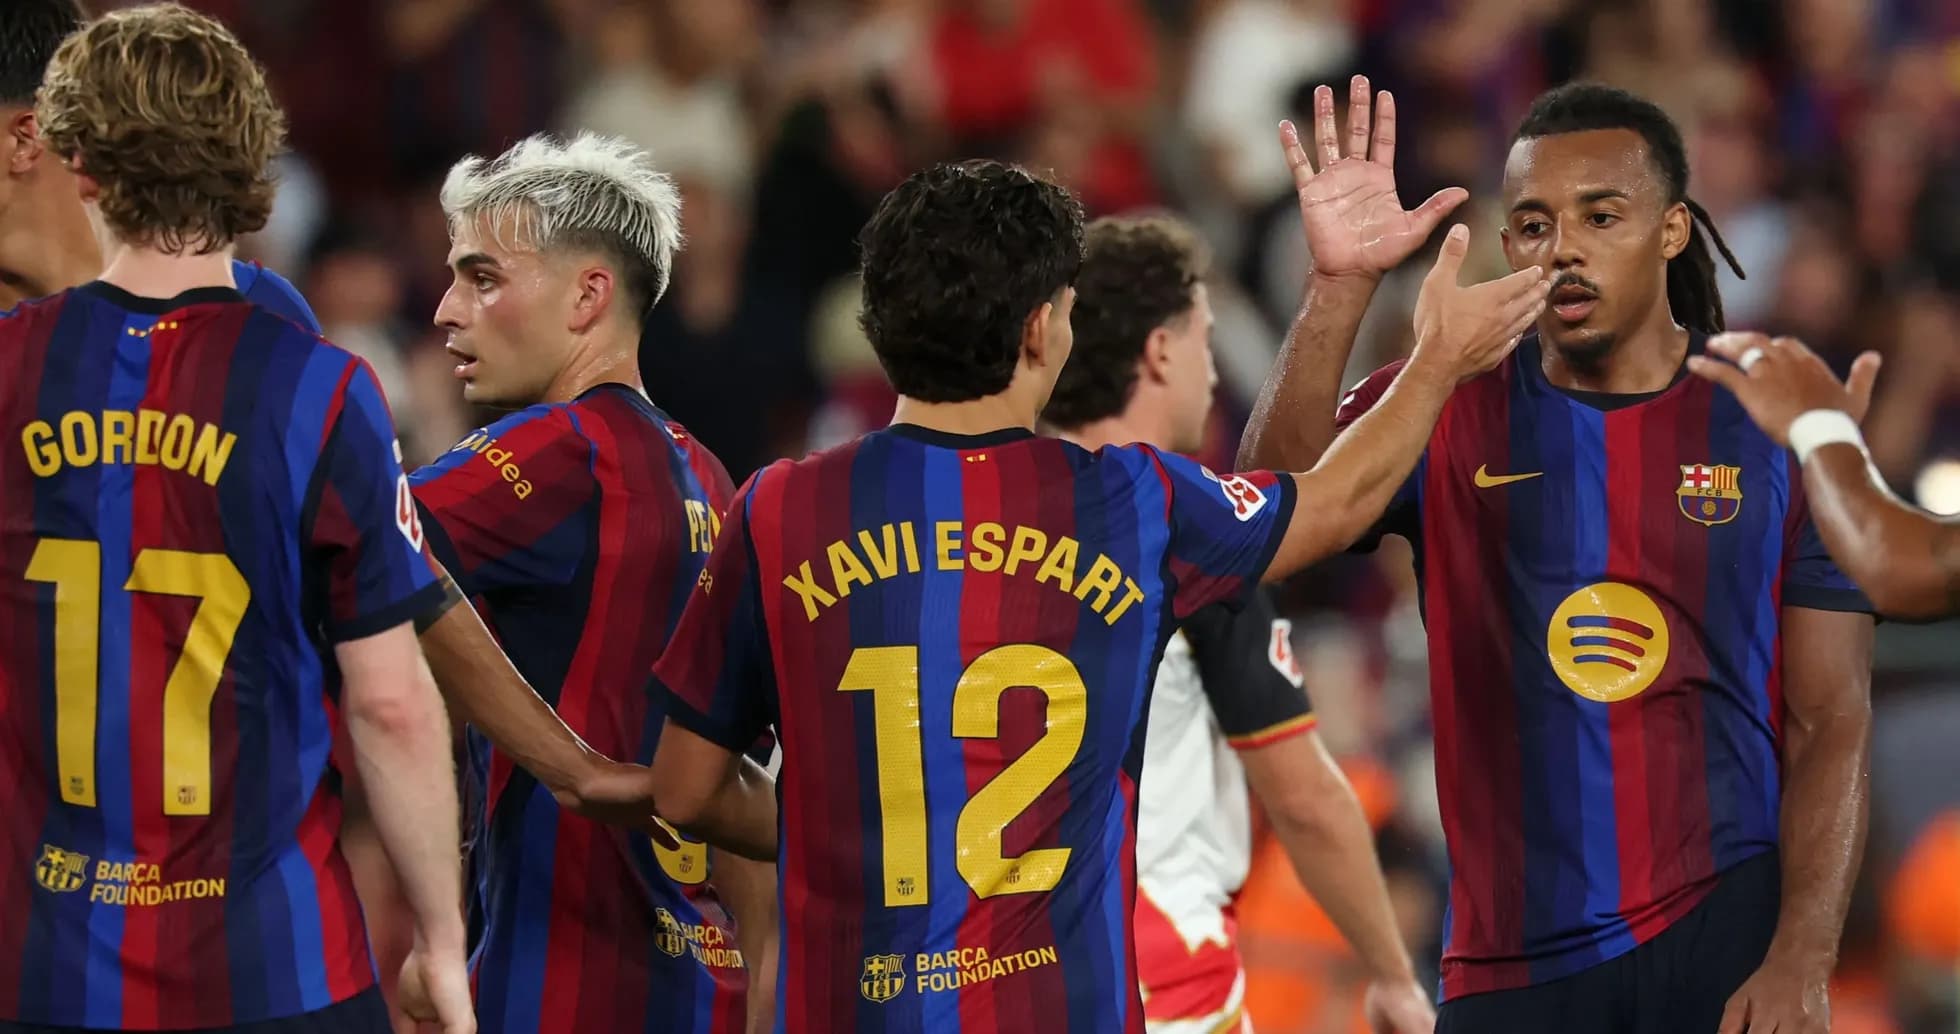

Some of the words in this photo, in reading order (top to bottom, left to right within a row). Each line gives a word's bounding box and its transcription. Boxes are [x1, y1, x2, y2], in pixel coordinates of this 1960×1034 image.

[21, 409, 238, 486] GORDON
[452, 428, 533, 500] Midea
[1696, 488, 1722, 497] FCB
[782, 520, 922, 623] XAVI
[935, 520, 1145, 627] ESPART
[24, 537, 251, 816] 17
[836, 643, 1088, 908] 12
[89, 878, 225, 906] FOUNDATION
[95, 860, 161, 885] BARÇA
[915, 946, 989, 972] BARÇA
[916, 946, 1058, 994] FOUNDATION
